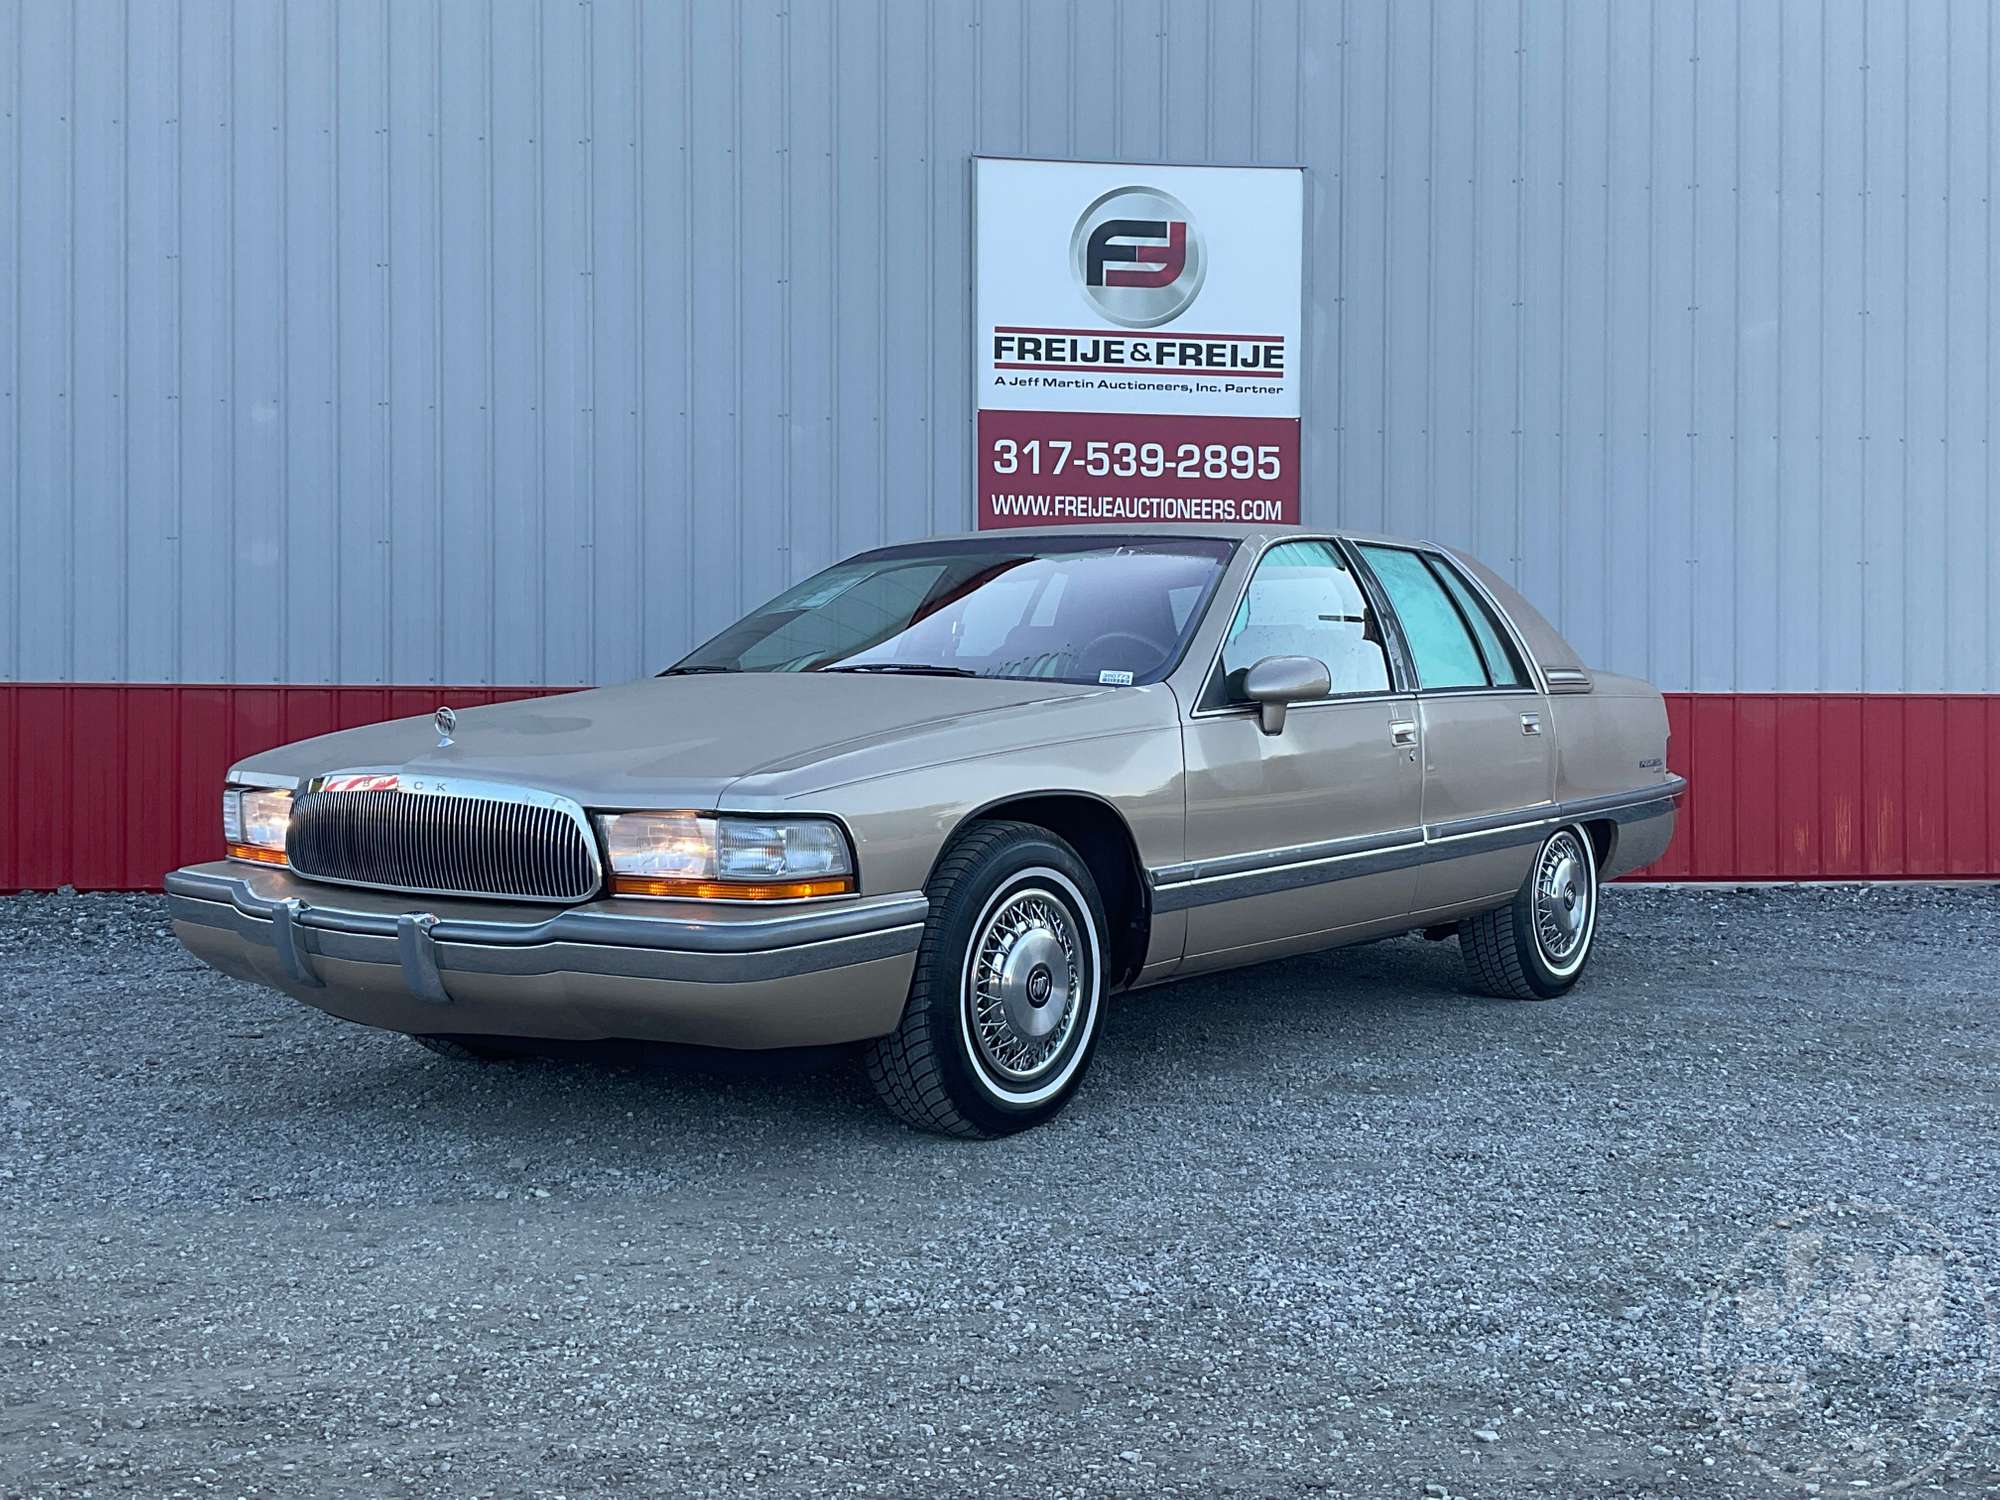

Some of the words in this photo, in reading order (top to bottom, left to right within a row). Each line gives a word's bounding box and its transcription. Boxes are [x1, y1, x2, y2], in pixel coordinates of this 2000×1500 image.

[994, 336, 1124, 363] FREIJE
[1130, 342, 1152, 362] &
[1155, 342, 1284, 368] FREIJE
[994, 376, 1006, 386] A
[1009, 376, 1040, 387] Jeff
[1042, 377, 1095, 389] Martin
[1097, 379, 1193, 394] Auctioneers,
[1196, 382, 1222, 393] Inc.
[1225, 383, 1285, 395] Partner
[993, 438, 1281, 481] 317-539-2895
[991, 494, 1282, 521] WWW.FREIJEAUCTIONEERS.COM
